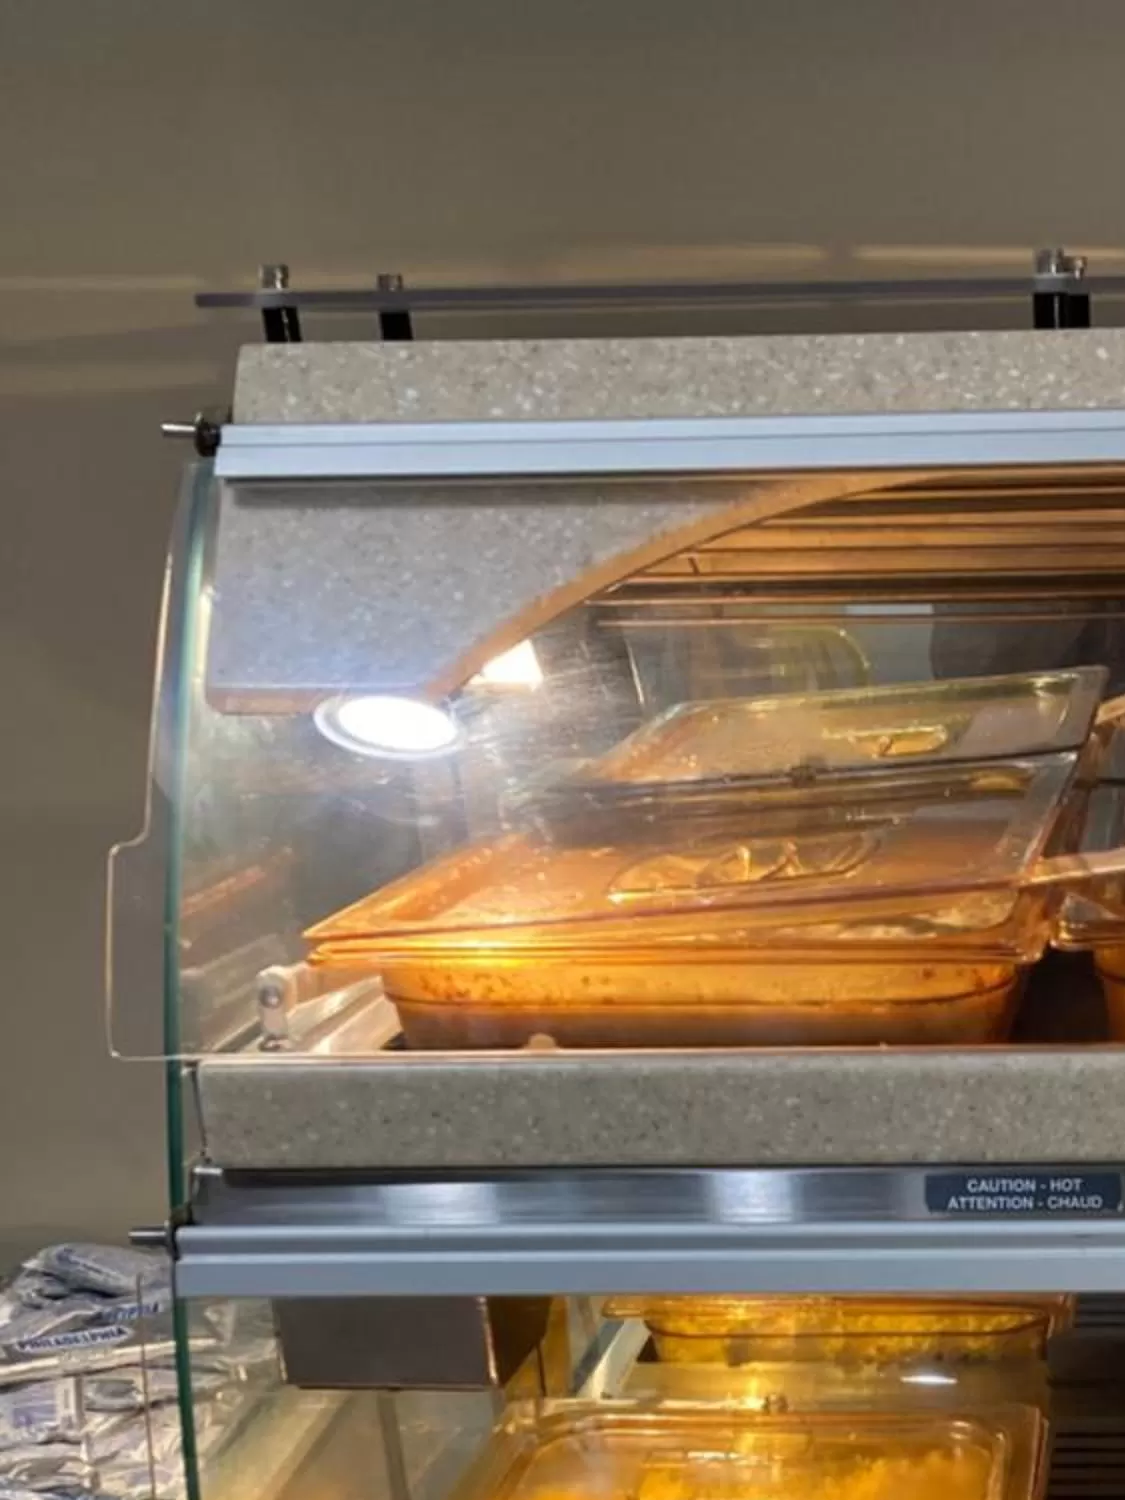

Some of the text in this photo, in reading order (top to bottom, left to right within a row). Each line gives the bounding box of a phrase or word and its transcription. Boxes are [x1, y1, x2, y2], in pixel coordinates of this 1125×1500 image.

[967, 1178, 1036, 1193] CAUTION
[1050, 1178, 1082, 1192] HOT
[948, 1196, 1034, 1210] ATTENTION
[1047, 1195, 1103, 1209] CHAUD
